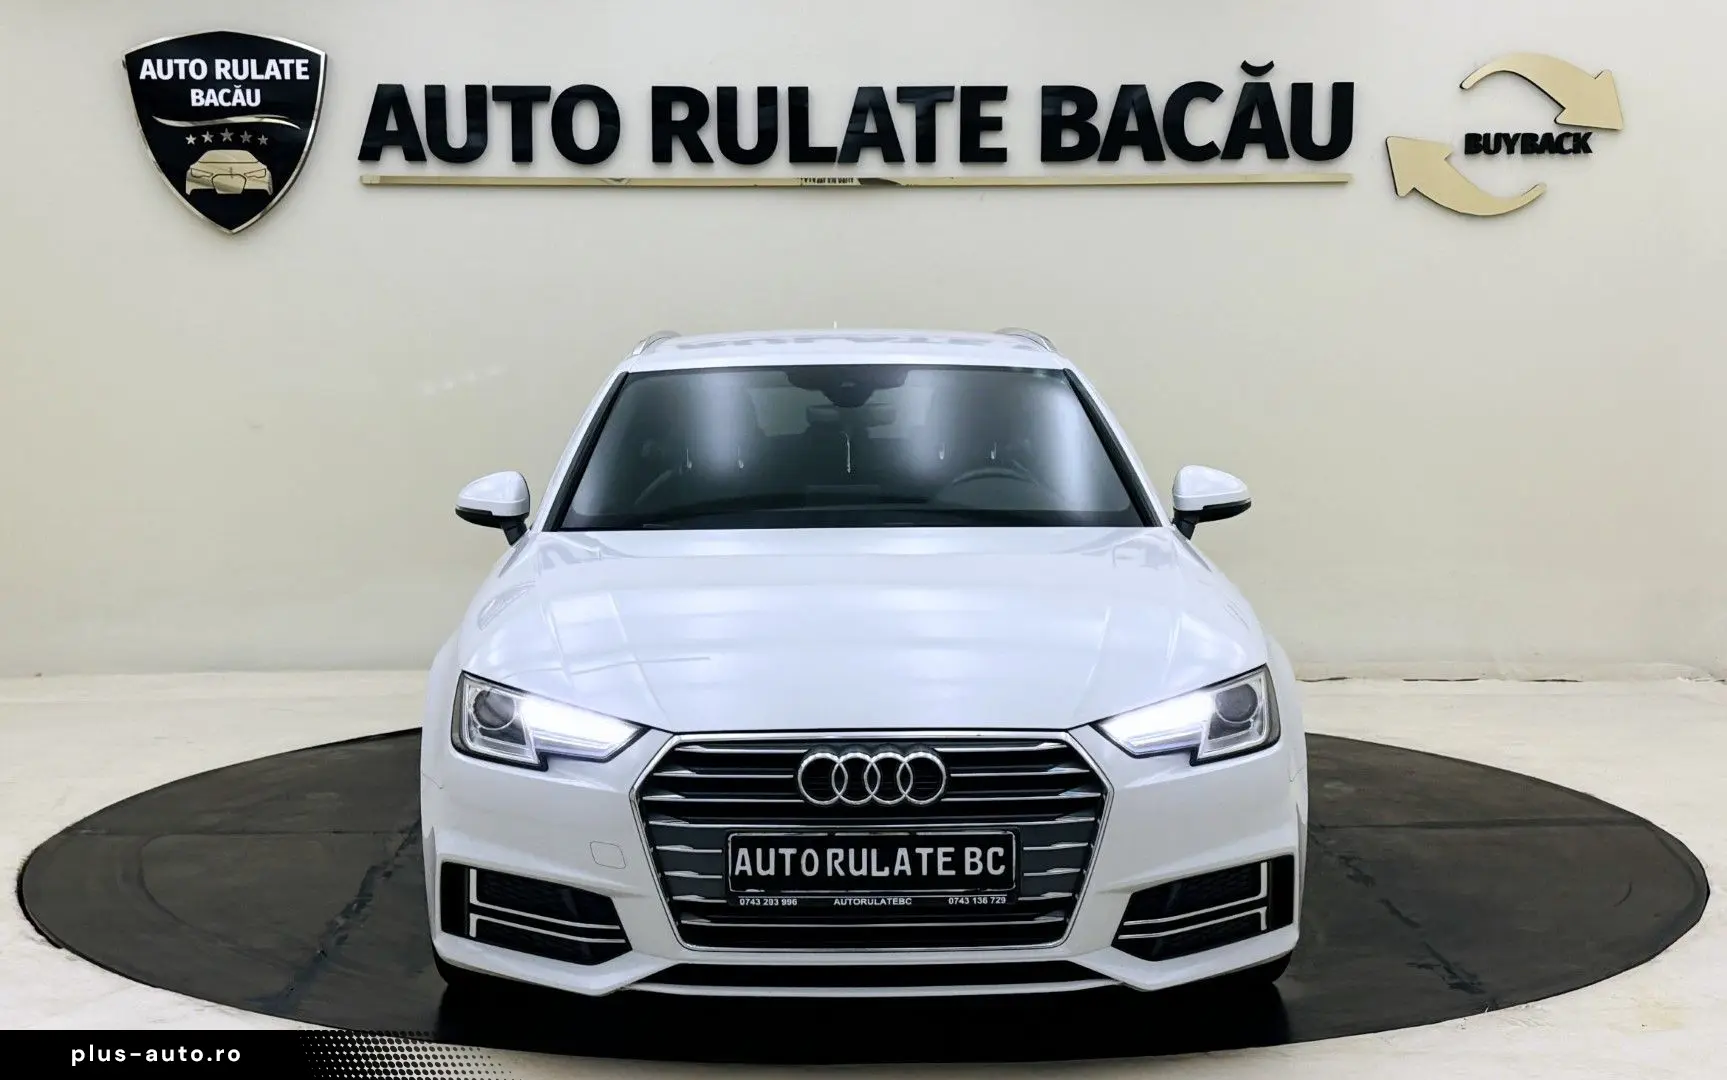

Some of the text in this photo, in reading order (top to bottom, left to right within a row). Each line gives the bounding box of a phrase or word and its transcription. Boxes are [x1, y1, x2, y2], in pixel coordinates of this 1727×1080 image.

[139, 58, 309, 81] AUTO RULATE
[190, 85, 261, 107] BACĂU
[358, 60, 1354, 165] AUTO RULATE BACĂU
[1463, 132, 1593, 155] BUYBACK
[734, 847, 1006, 877] AUTO RULATE BC
[739, 898, 761, 906] 0743
[833, 897, 912, 906] AUTORULATEBC
[948, 896, 970, 905] 0743
